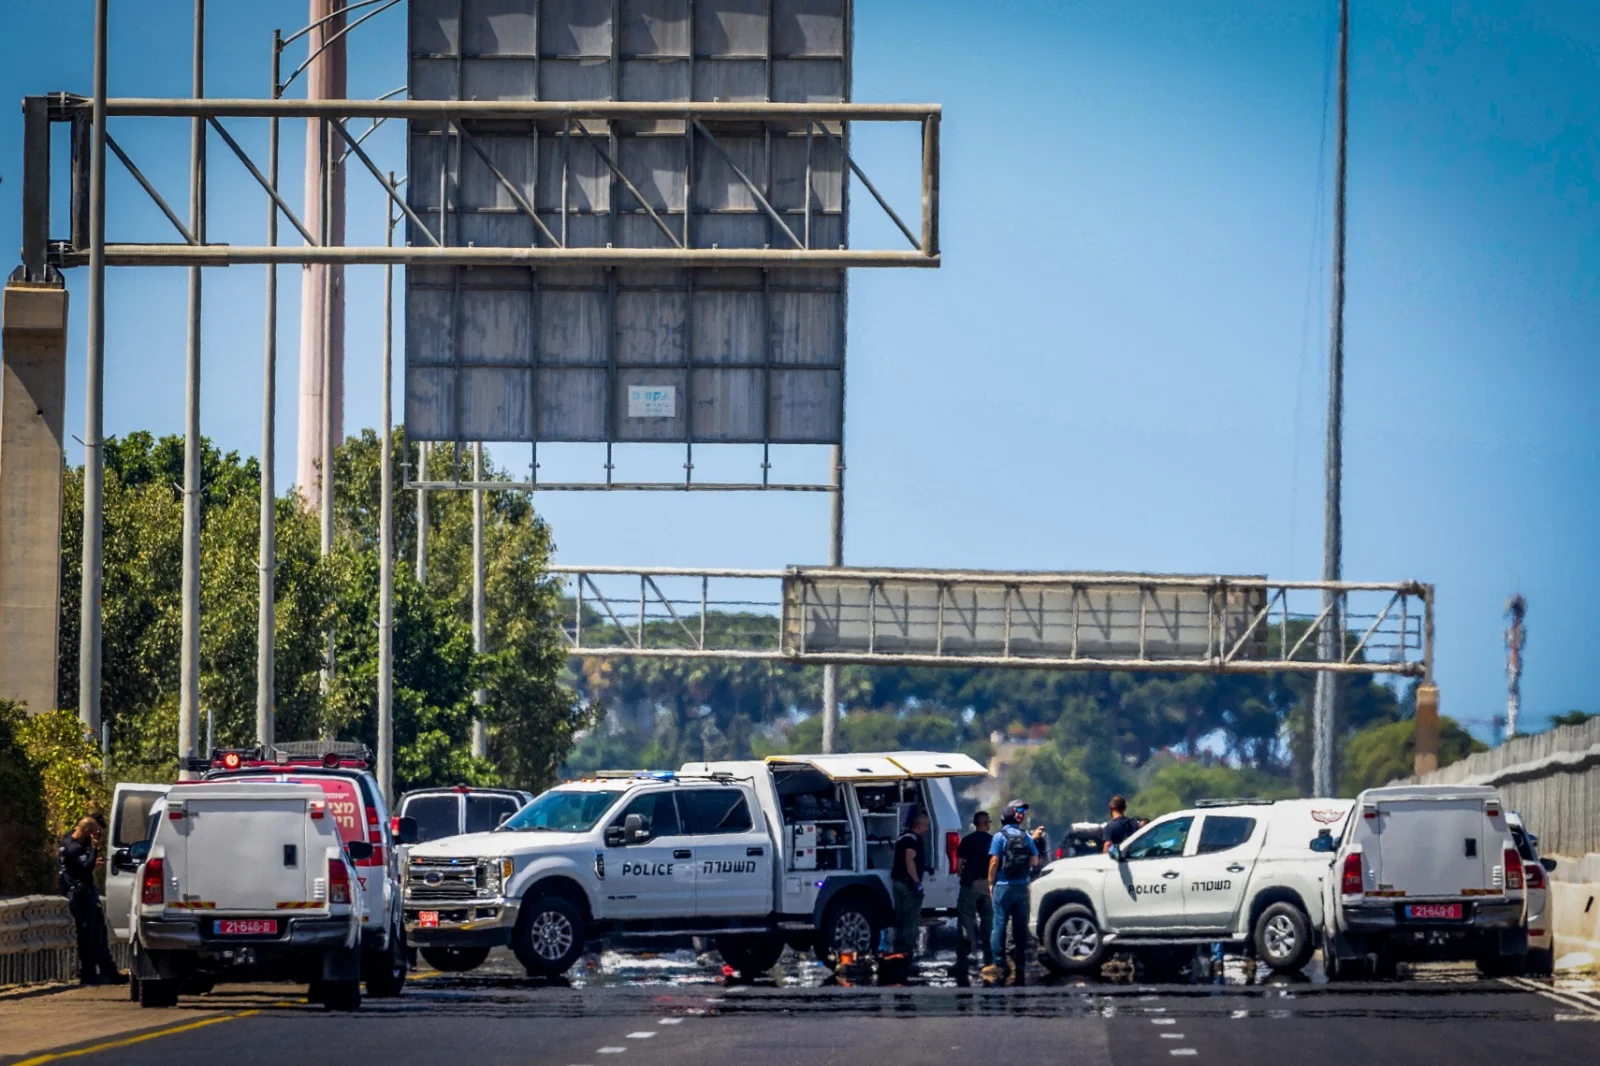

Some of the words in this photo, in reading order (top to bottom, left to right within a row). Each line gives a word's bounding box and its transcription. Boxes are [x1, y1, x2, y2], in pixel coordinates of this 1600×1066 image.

[329, 802, 354, 814] מצי
[334, 816, 354, 828] חי
[622, 863, 674, 876] POLICE
[703, 861, 756, 874] משטרה
[1128, 884, 1167, 895] POLICE
[1191, 879, 1232, 892] משטרה
